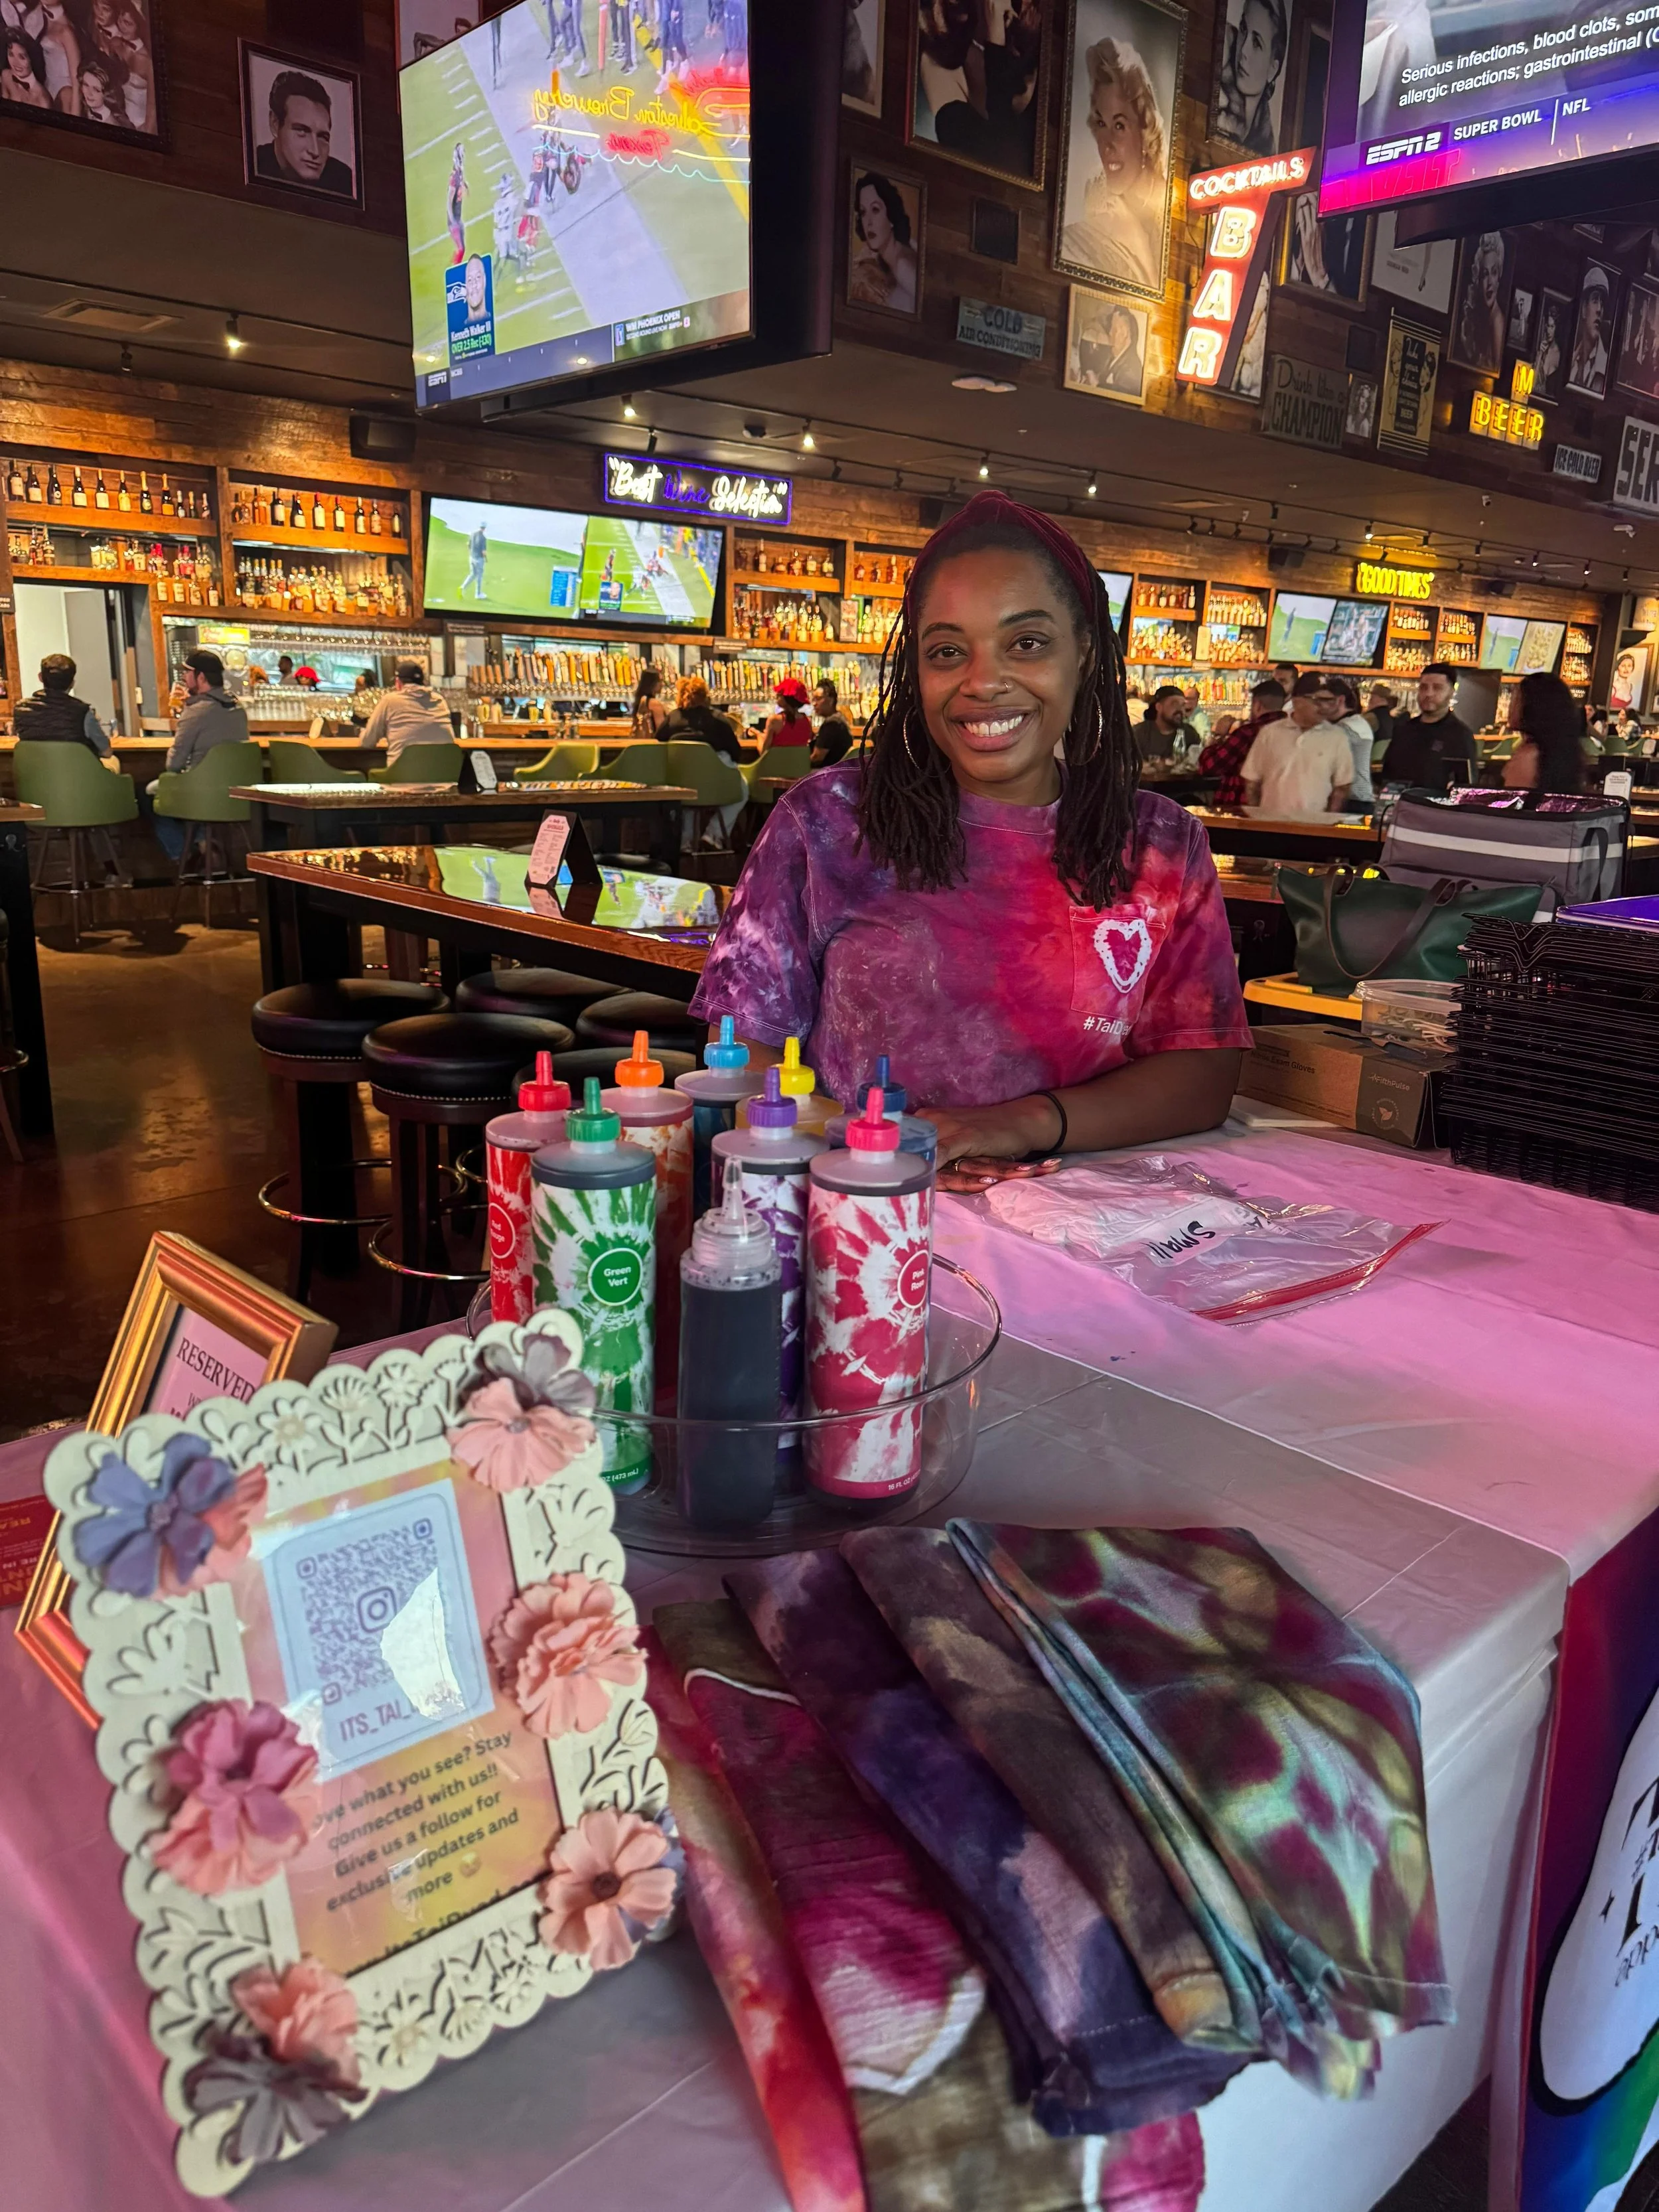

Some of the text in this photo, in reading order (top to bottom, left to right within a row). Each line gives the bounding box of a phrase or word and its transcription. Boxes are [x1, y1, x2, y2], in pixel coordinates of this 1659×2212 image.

[1402, 59, 1453, 85] Serious
[1457, 40, 1529, 70] infections,
[1533, 24, 1576, 51] blood
[1579, 16, 1621, 38] clots,
[1398, 84, 1448, 108] allergic
[1451, 65, 1522, 94] reactions;
[1524, 31, 1643, 80] gastrointestinal
[1453, 117, 1498, 141] SUPER
[1501, 109, 1542, 129] BOWL
[1562, 98, 1591, 117] NFL
[1190, 156, 1305, 200] COCKTAILS
[1177, 206, 1257, 379] BAR
[637, 315, 664, 330] PHOENIX
[664, 309, 681, 323] OPEN
[983, 305, 1023, 334] COLD
[959, 325, 1041, 357] AIR CONDITIONING
[428, 371, 447, 387] ESPN
[1277, 358, 1313, 395] Drink
[1271, 391, 1344, 445] CHAMPION
[1476, 396, 1545, 443] BEER
[1555, 446, 1600, 480] ICE COLD BEER
[664, 469, 711, 504] Wine
[1291, 1061, 1315, 1074] Gloves
[1376, 1076, 1410, 1091] FifthPulse
[1141, 1220, 1216, 1260] Small
[603, 1266, 632, 1278] Green
[608, 1277, 628, 1288] Vert
[910, 1280, 925, 1291] Rose
[912, 1268, 924, 1280] Pink
[175, 1337, 256, 1405] RESERVED
[612, 1472, 627, 1482] (473
[349, 1781, 396, 1811] what
[397, 1766, 431, 1795] you
[435, 1745, 472, 1774] see?
[474, 1731, 512, 1757] Stay
[328, 1762, 498, 1851] connected with us!!
[335, 1790, 502, 1878] Give us a follow for
[326, 1807, 520, 1912] exclusive updates and
[406, 1870, 454, 1901] more
